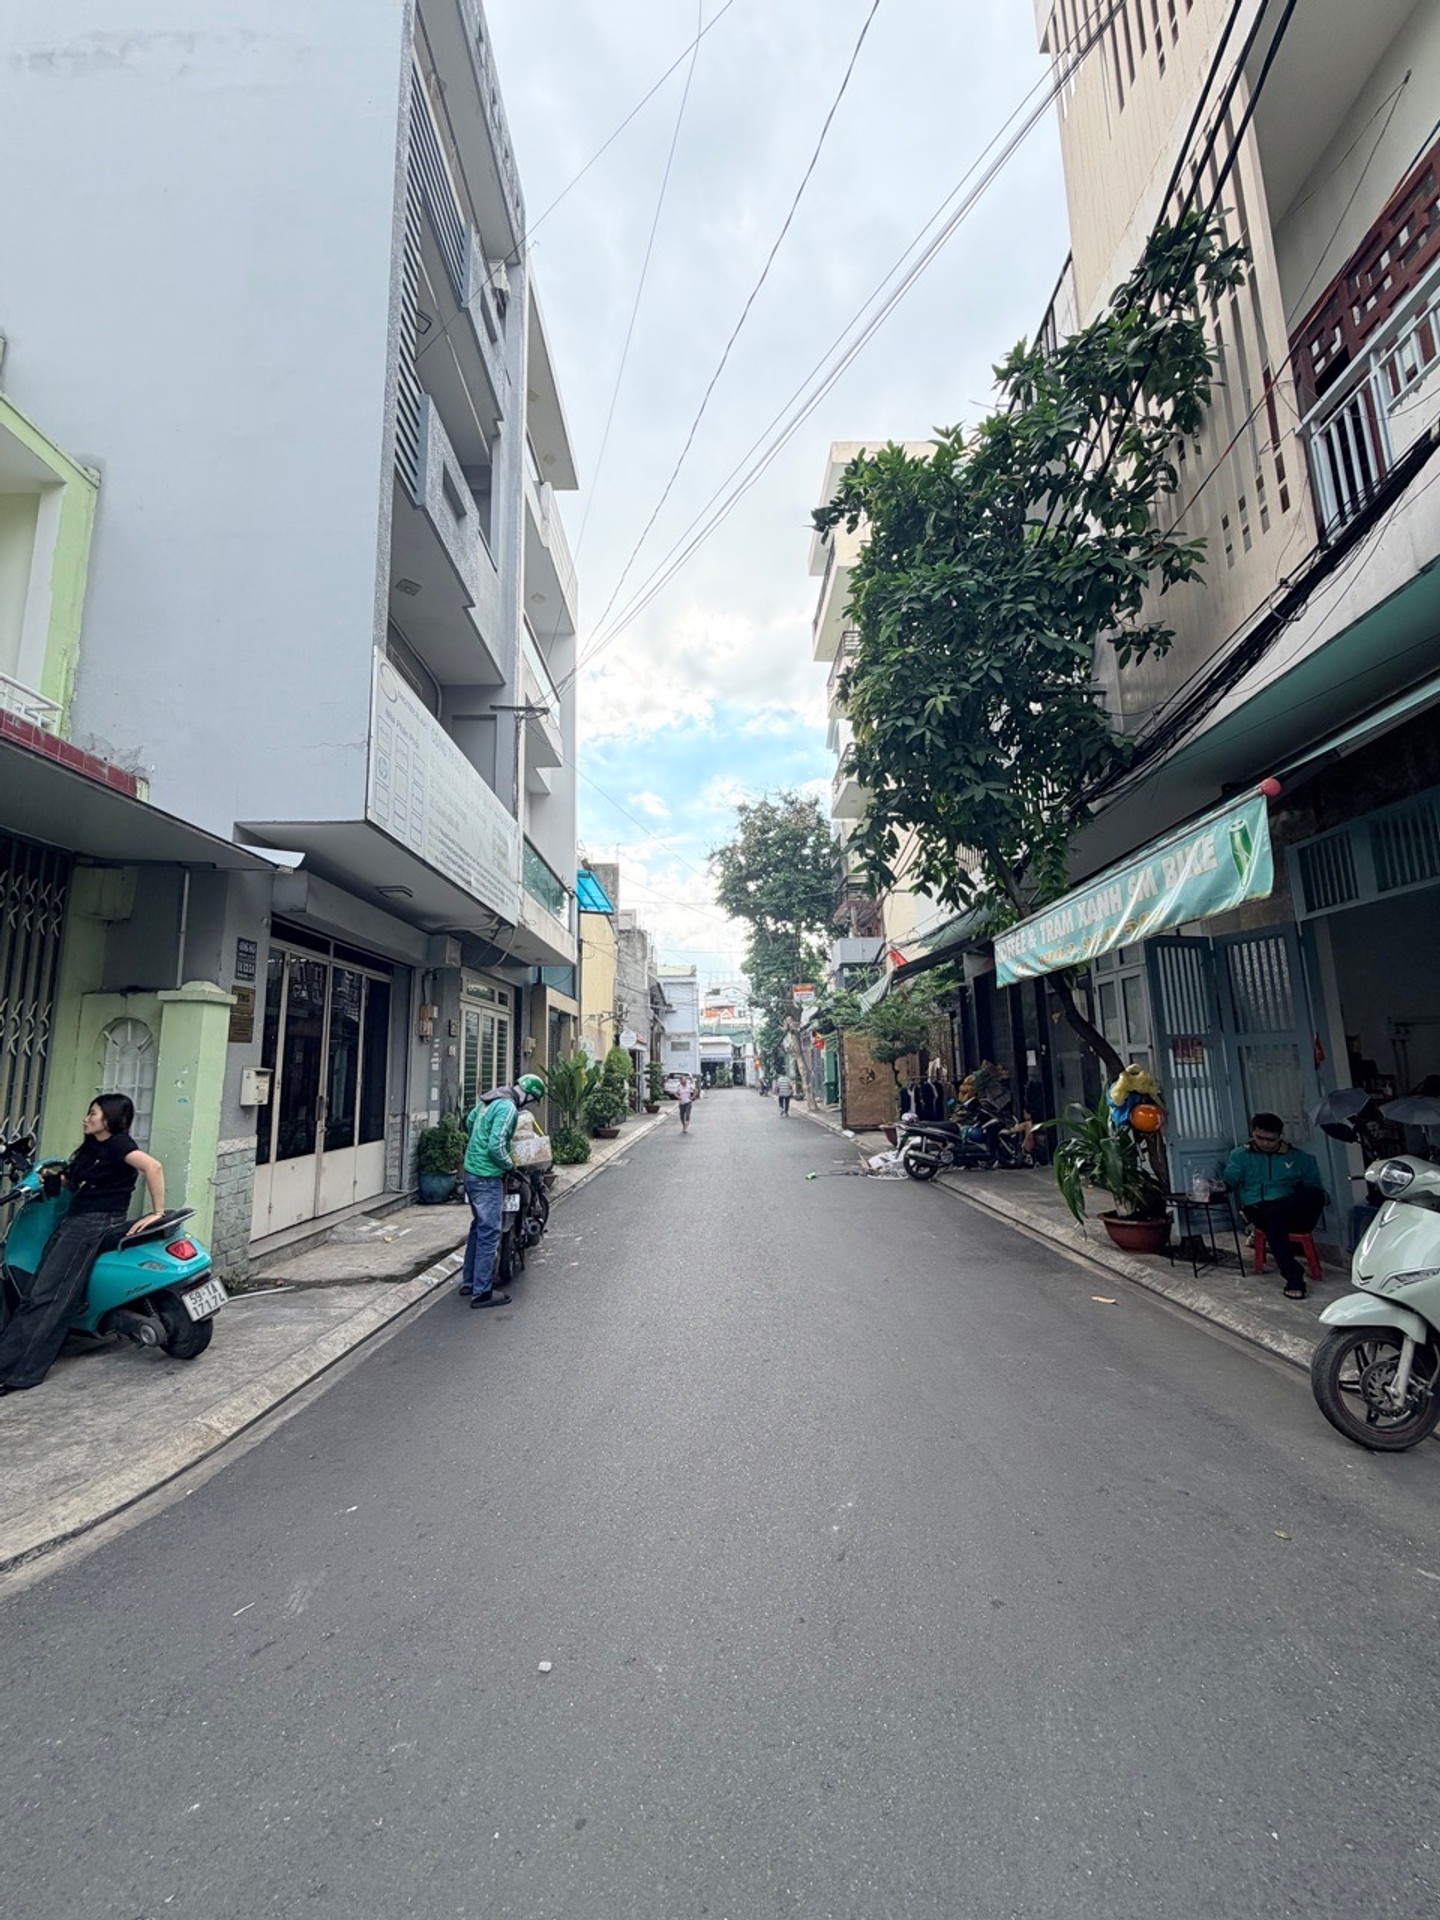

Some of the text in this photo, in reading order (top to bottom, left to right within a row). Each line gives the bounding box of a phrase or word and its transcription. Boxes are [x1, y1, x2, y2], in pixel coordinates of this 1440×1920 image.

[1040, 909, 1074, 944] TRẠM
[1077, 884, 1123, 928] XANH
[1128, 866, 1159, 901] SM
[1161, 832, 1218, 890] BIKE
